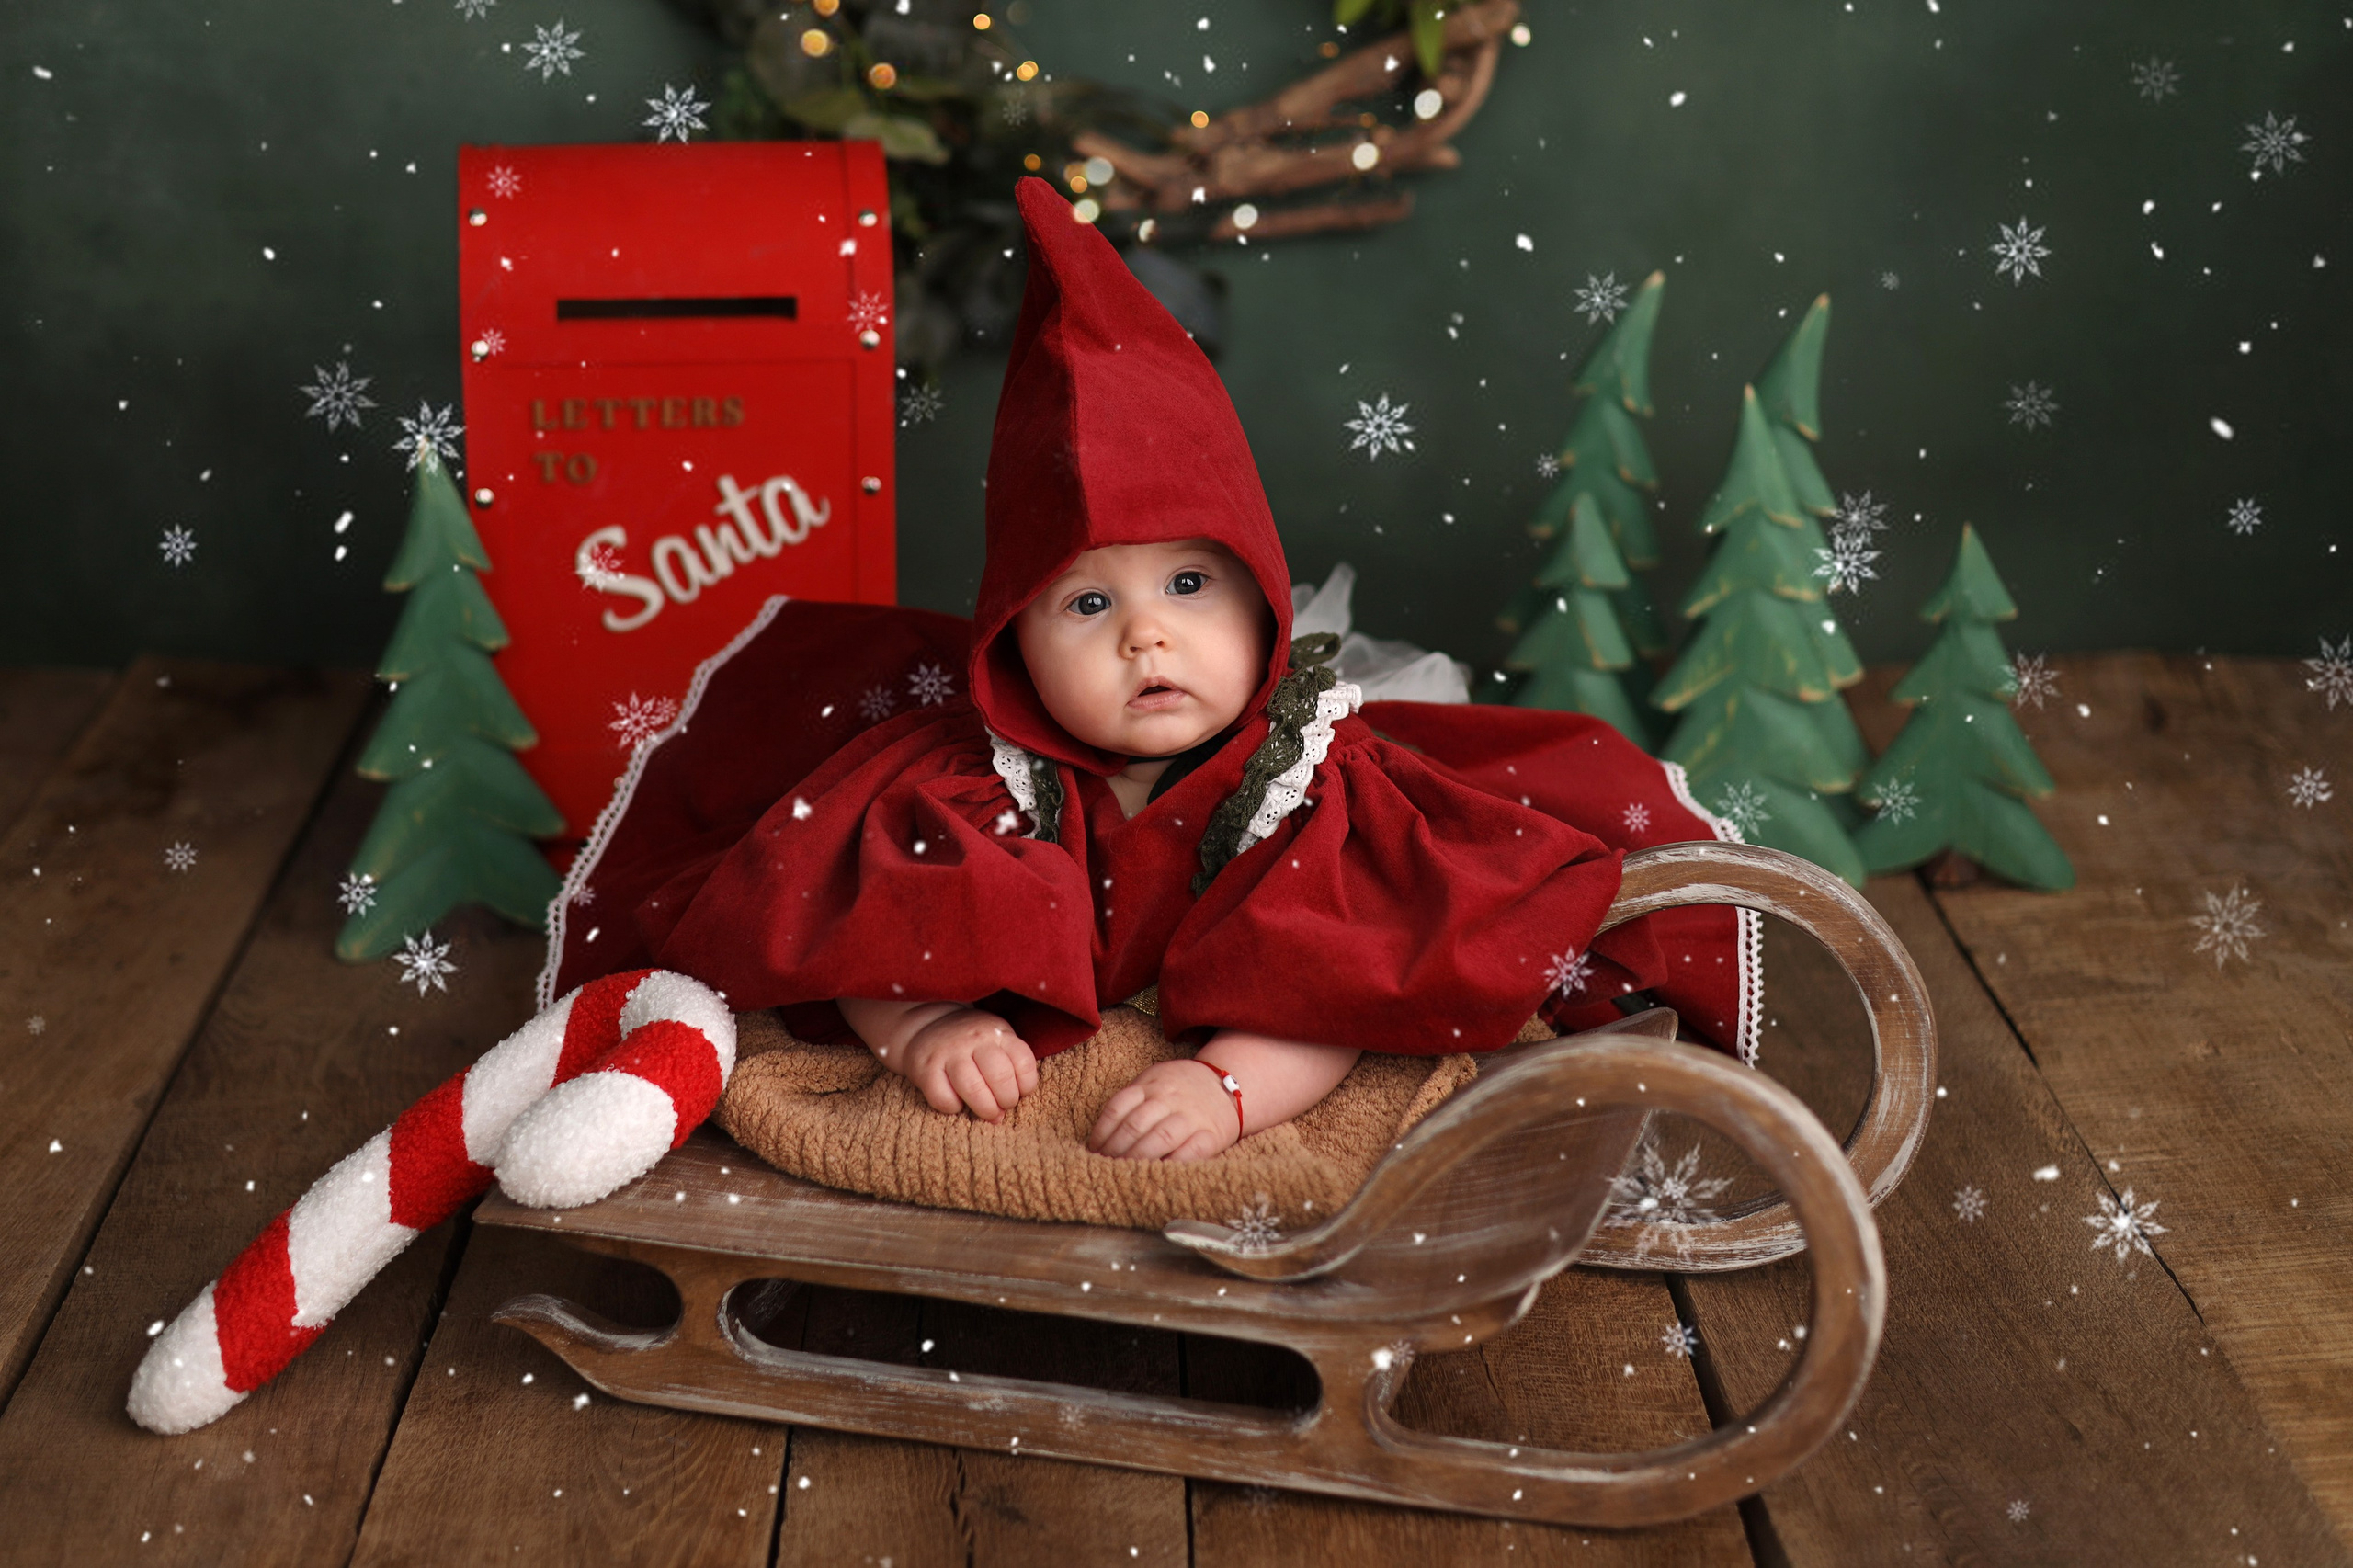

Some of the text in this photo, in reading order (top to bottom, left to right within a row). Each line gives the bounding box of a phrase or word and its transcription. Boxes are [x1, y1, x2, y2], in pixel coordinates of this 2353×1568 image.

[531, 397, 745, 430] LETTERS
[533, 451, 598, 485] TO
[575, 473, 831, 632] Santa
